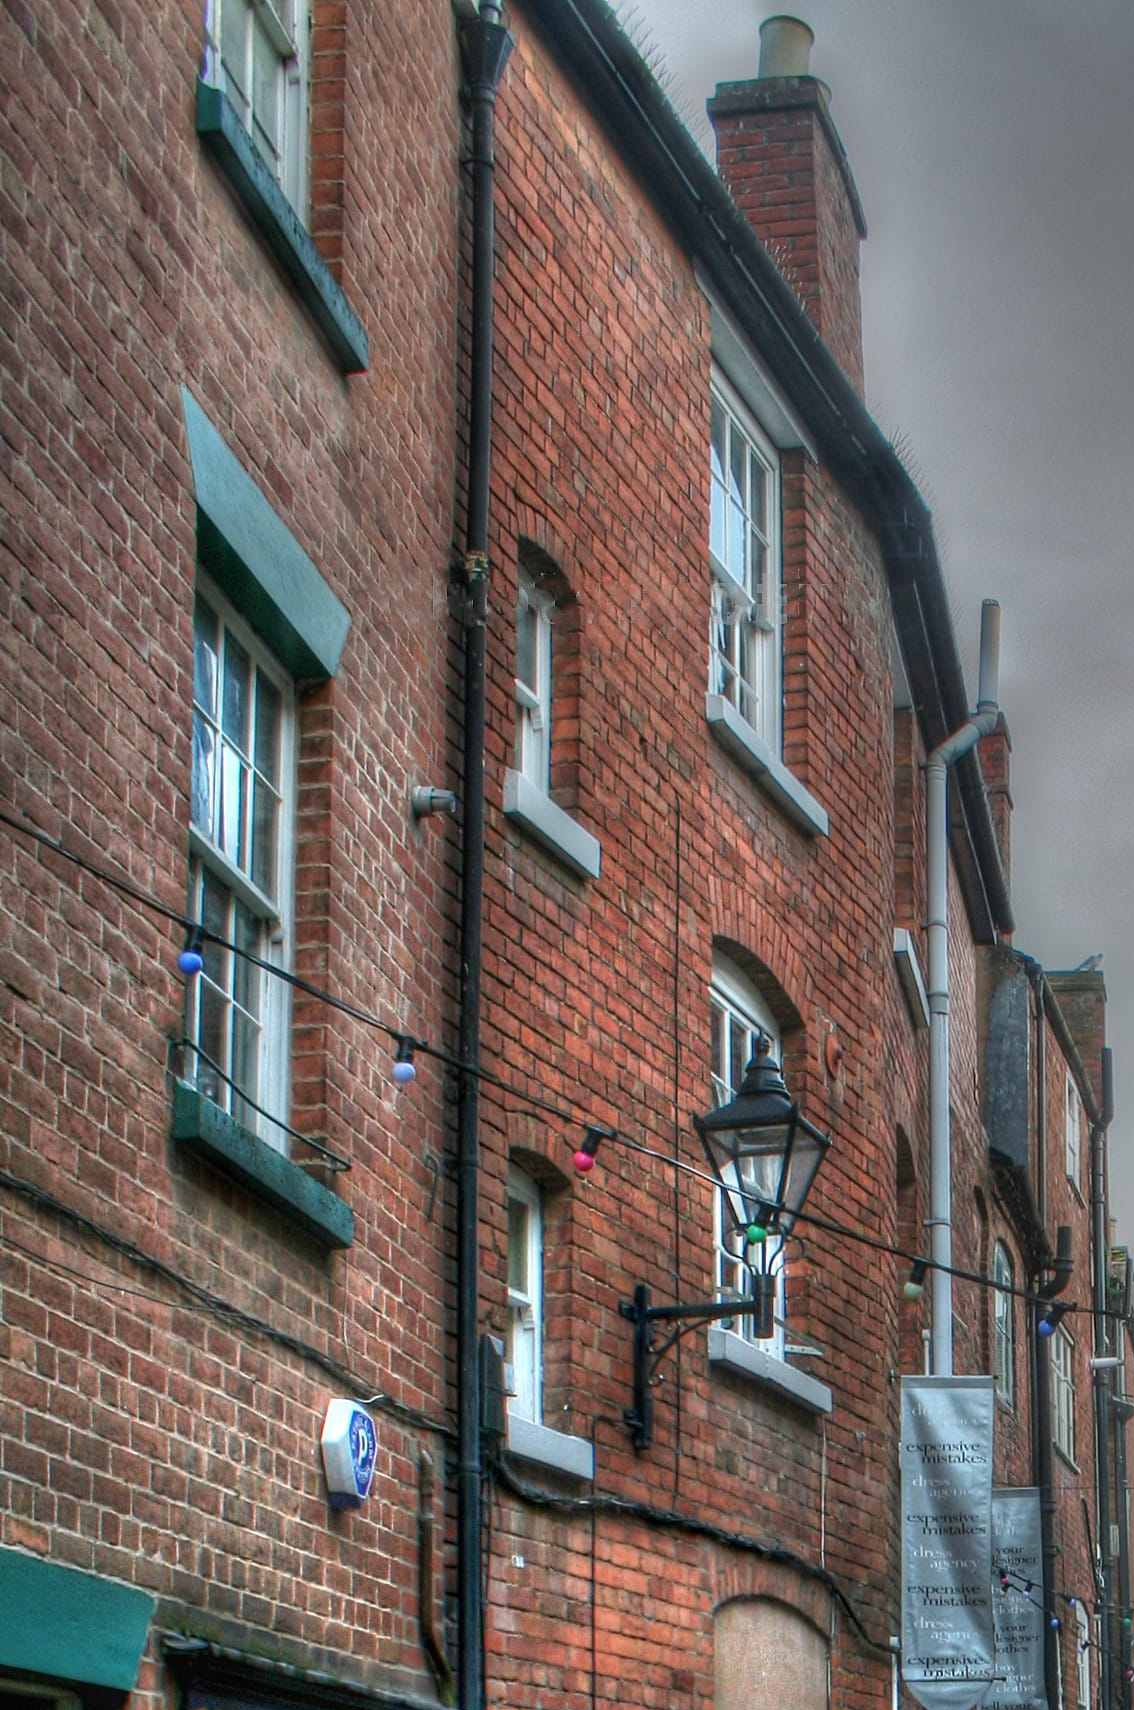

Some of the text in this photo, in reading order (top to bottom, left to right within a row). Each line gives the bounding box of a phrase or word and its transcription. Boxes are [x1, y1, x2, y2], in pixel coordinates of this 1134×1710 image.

[906, 1441, 981, 1456] expensive
[921, 1451, 987, 1464] mistakes
[906, 1511, 980, 1526] expensive
[922, 1523, 986, 1536] mistakes
[913, 1544, 953, 1558] dress
[929, 1559, 979, 1573] agency
[907, 1583, 981, 1598] expensive
[922, 1594, 987, 1607] mistakes
[913, 1616, 954, 1629] dress
[1000, 1624, 1029, 1634] your
[907, 1654, 985, 1669] expensive
[922, 1664, 991, 1680] mistakes
